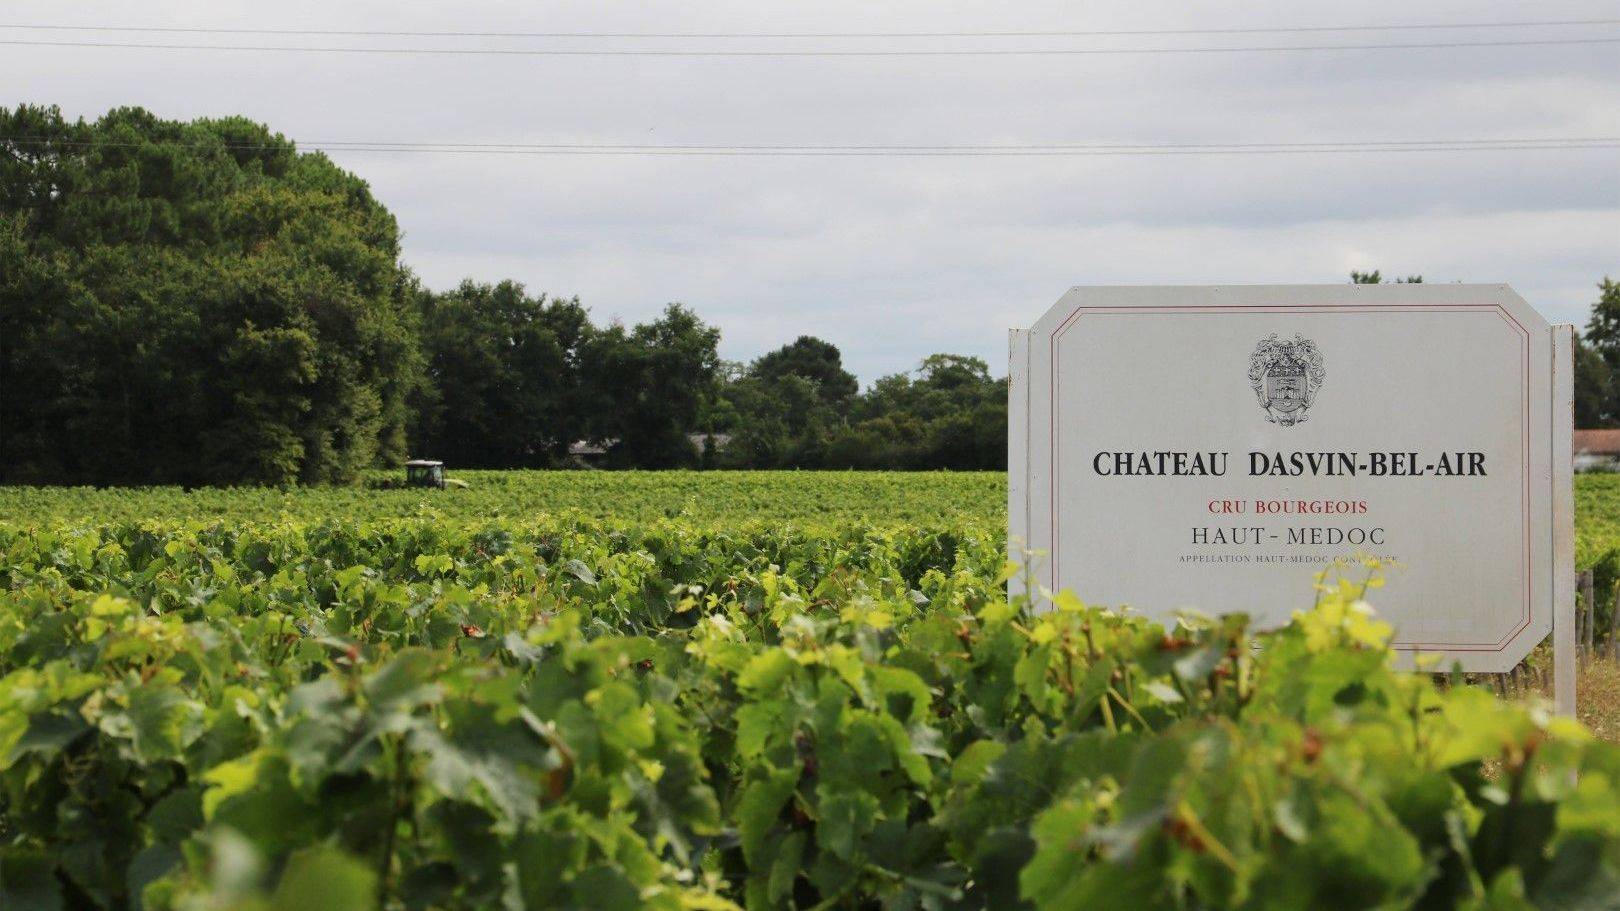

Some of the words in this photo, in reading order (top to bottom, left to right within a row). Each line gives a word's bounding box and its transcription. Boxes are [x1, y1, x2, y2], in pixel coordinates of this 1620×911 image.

[1093, 451, 1229, 476] CHATEAU
[1248, 451, 1488, 477] DASVIN-BEL-AIR
[1208, 500, 1247, 515] CRU
[1255, 500, 1368, 515] BOURGEOIS
[1179, 554, 1251, 564] APPELLATION
[1256, 554, 1328, 564] HAUT-MEDOC
